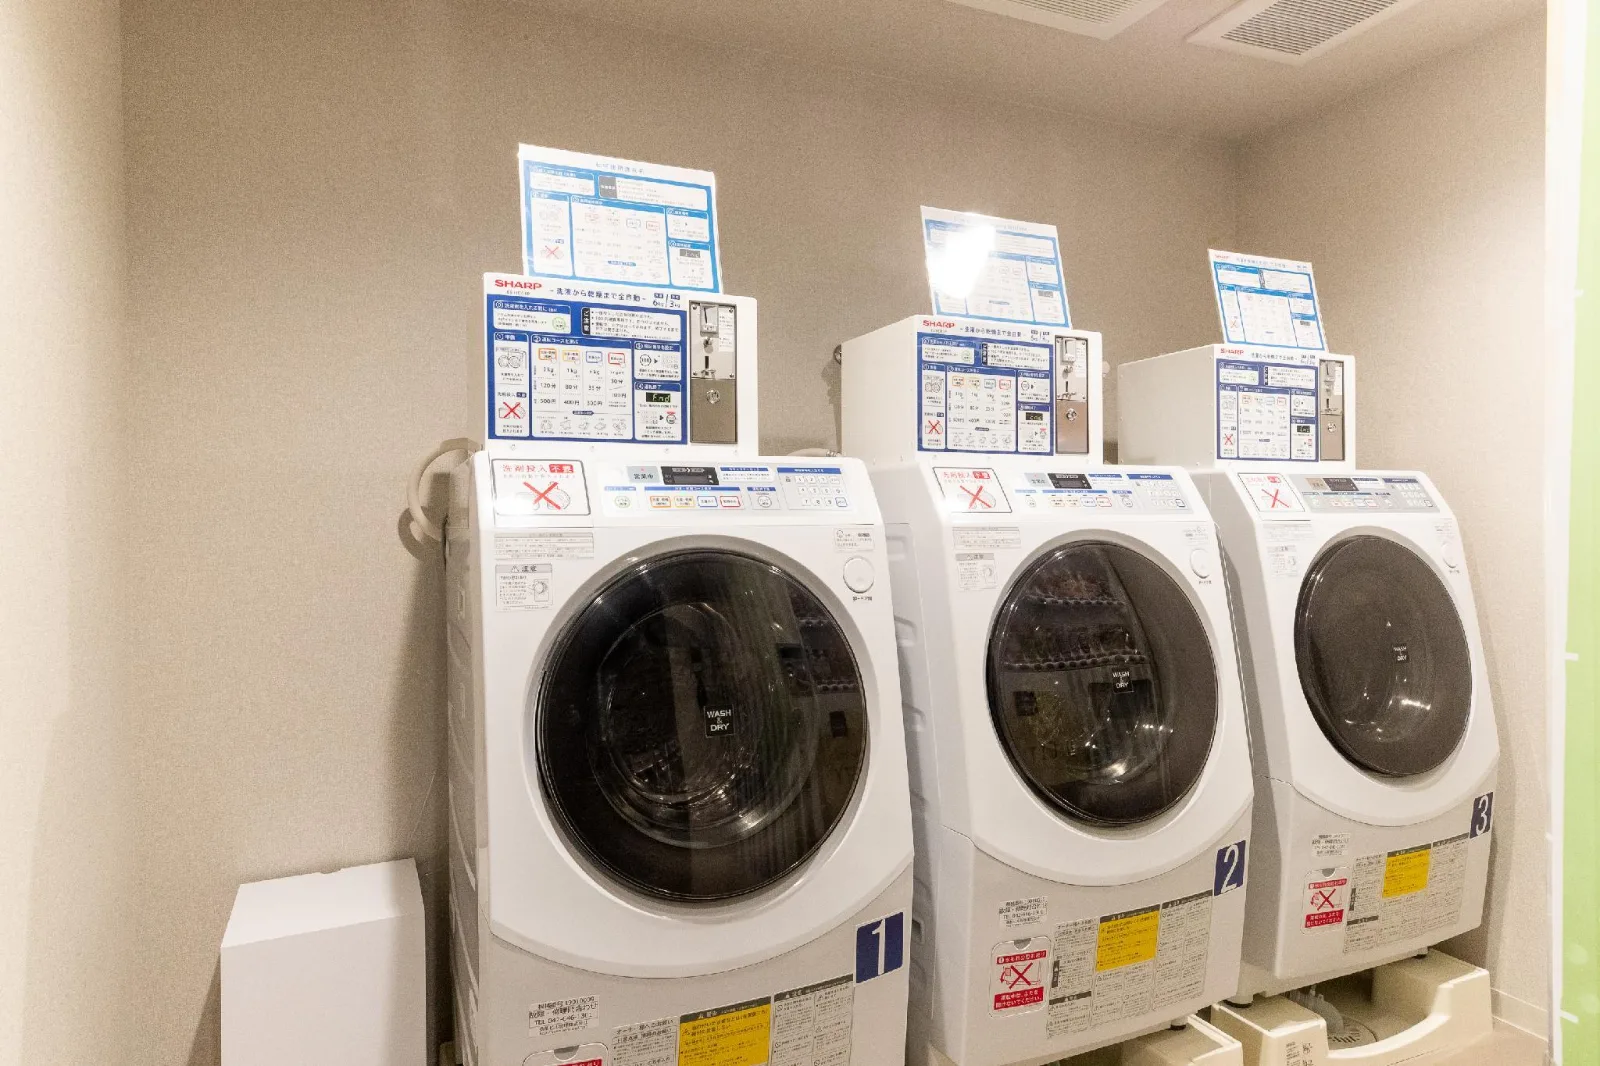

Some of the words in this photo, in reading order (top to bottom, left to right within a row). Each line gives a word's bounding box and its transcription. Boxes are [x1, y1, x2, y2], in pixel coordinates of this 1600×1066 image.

[494, 279, 542, 290] SHARP
[922, 319, 955, 329] SHARP
[706, 709, 731, 718] WASH
[710, 723, 730, 731] DRY
[1475, 795, 1489, 836] 3
[1220, 844, 1239, 894] 2
[871, 918, 886, 976] 1
